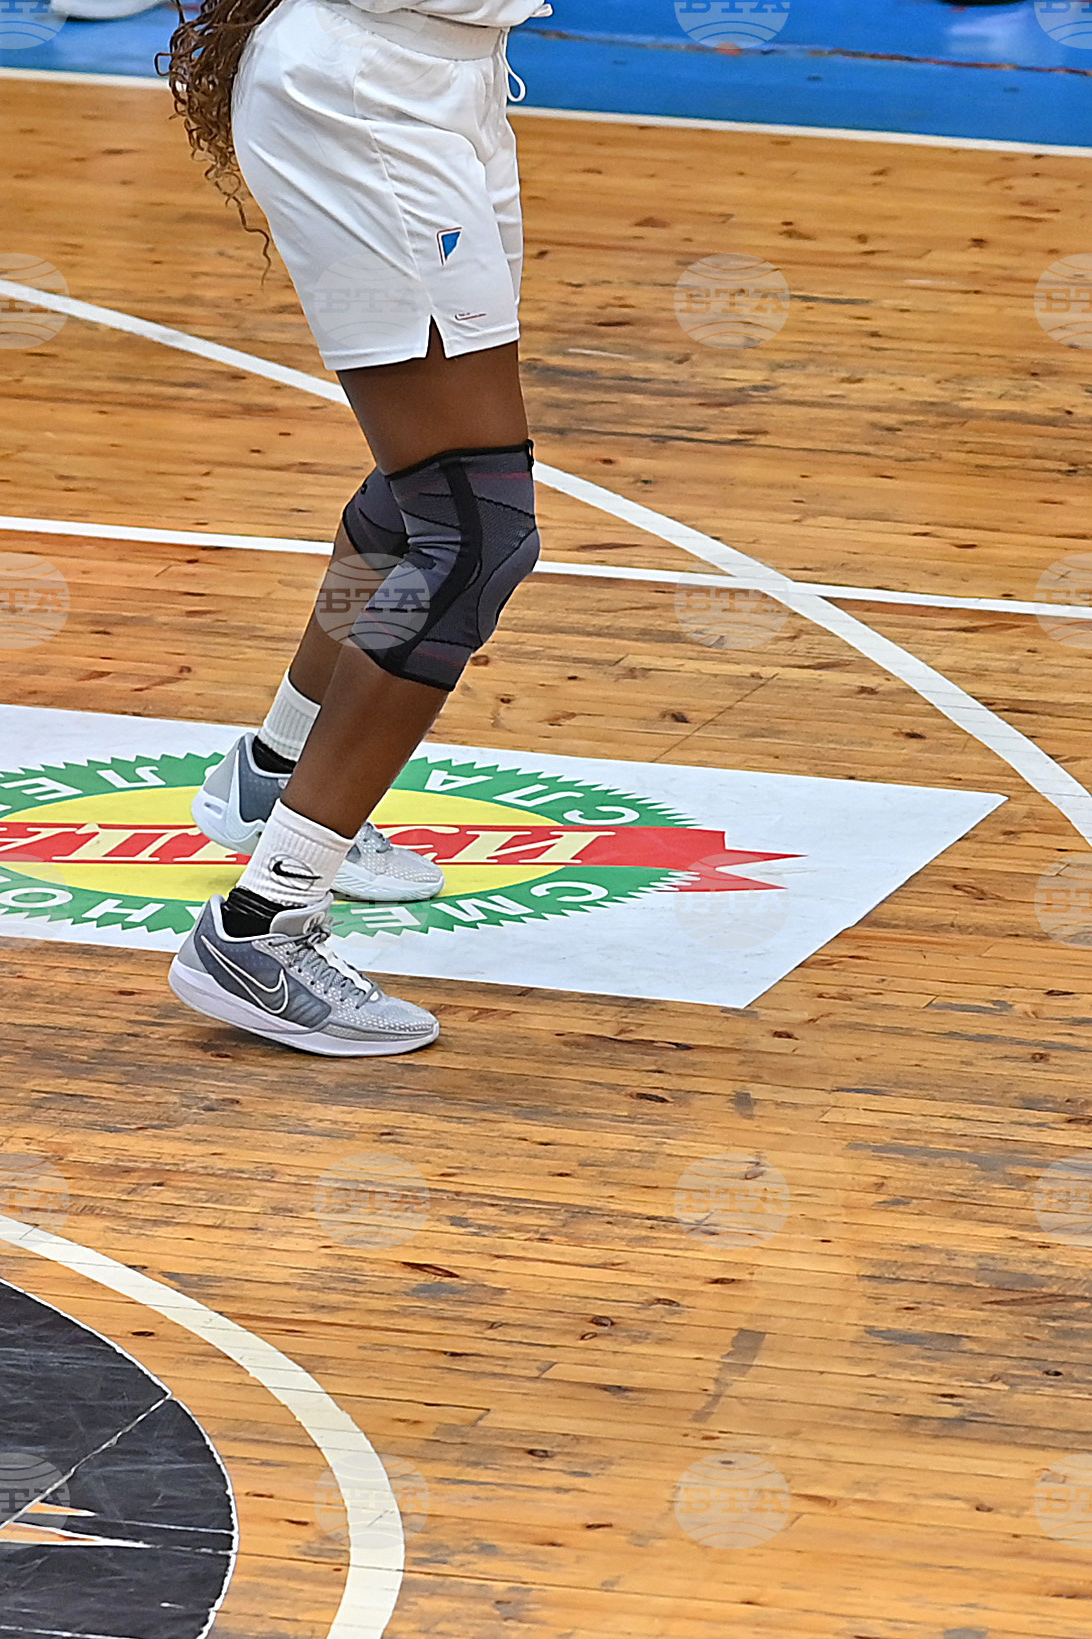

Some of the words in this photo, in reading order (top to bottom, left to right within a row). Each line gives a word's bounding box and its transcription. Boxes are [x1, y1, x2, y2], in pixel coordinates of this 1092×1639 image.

[0, 766, 640, 826] СЛАЛЕ
[0, 823, 616, 864] ИЗД
[0, 877, 609, 932] СМЕНО
